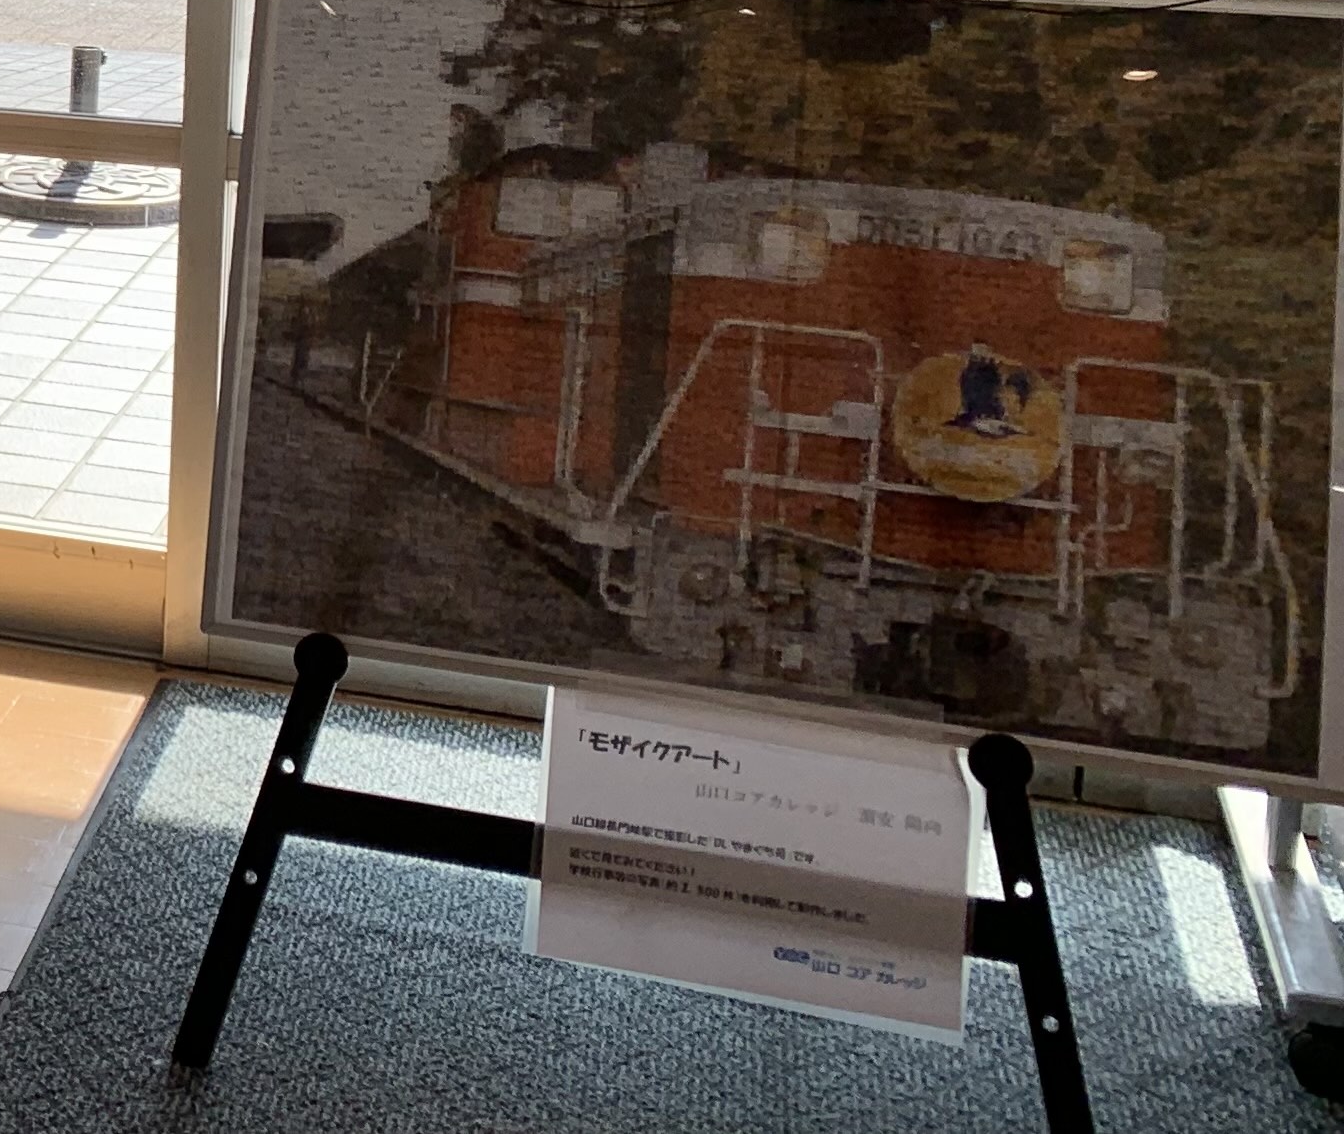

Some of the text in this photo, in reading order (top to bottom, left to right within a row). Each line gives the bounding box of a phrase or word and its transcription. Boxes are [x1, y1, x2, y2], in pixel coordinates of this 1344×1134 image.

[577, 727, 743, 776] 「モザイクアート」
[695, 783, 839, 819] 山口コアカレッジ
